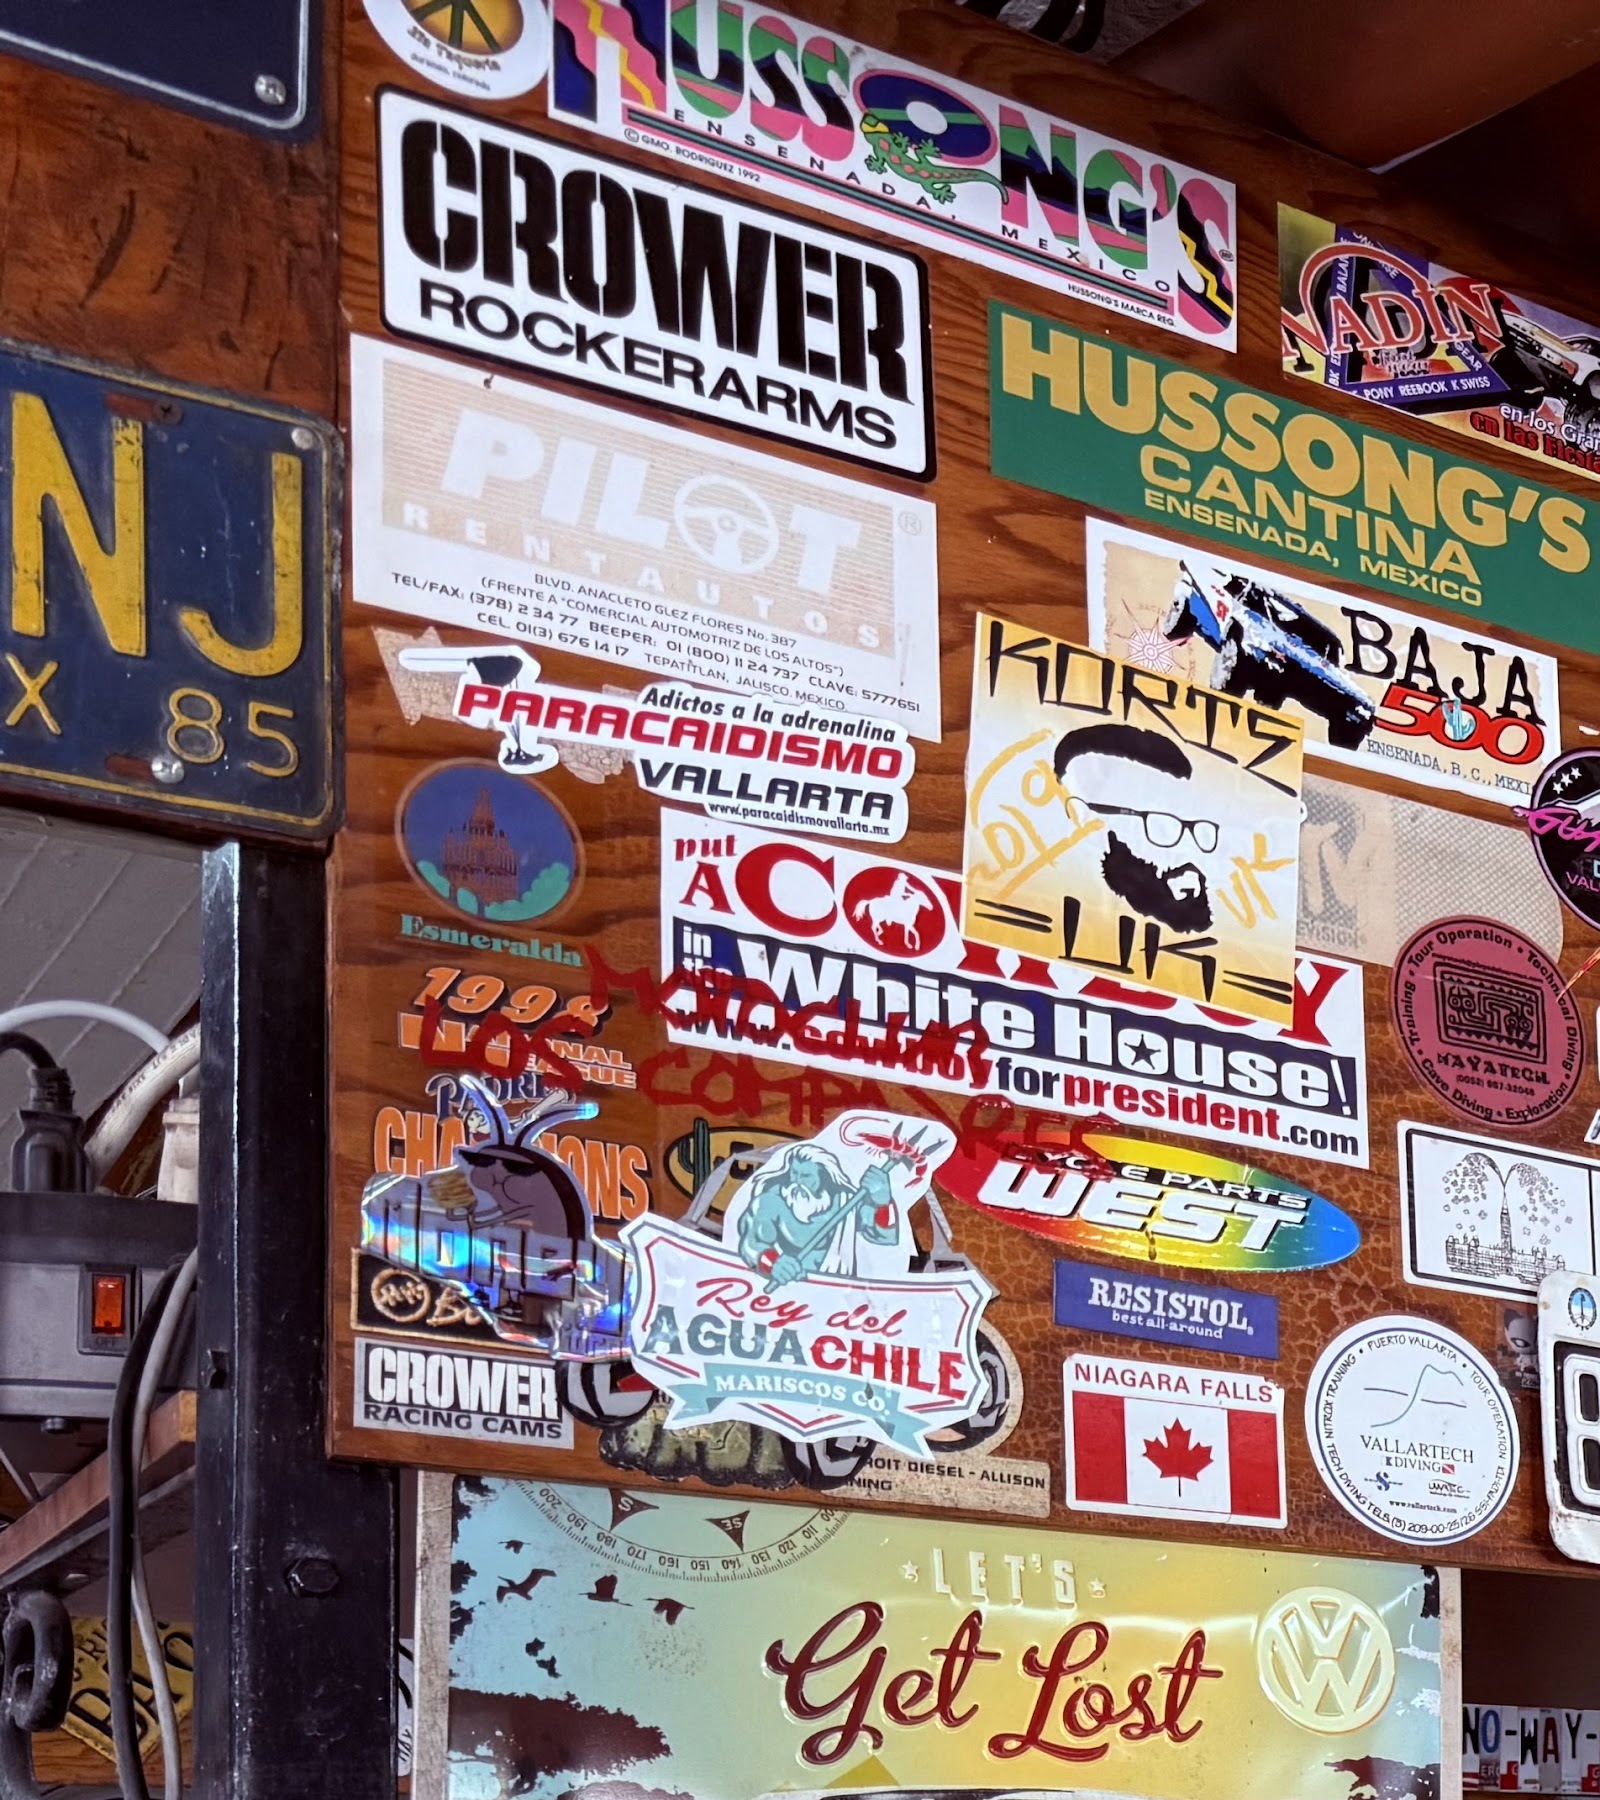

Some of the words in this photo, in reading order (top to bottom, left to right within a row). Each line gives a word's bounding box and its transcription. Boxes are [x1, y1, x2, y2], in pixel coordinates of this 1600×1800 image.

[676, 146, 734, 175] RODRIGUEZ
[736, 167, 761, 182] 1992
[674, 108, 955, 220] ENSENADA,
[1001, 224, 1171, 293] MEXICO
[401, 120, 912, 405] CROWER
[420, 278, 897, 450] ROCKERARMS
[1364, 386, 1394, 400] PONY
[1399, 380, 1448, 398] REEBOOK
[1002, 313, 1590, 572] HUSSONG'S
[1141, 445, 1480, 584] CANTINA
[1145, 489, 1340, 567] ENSENADA,
[1360, 555, 1482, 606] MEXICO
[579, 582, 650, 616] ANACLETO
[691, 609, 743, 637] FLORES
[651, 618, 741, 655] AUTOMOTRIZ
[1341, 607, 1545, 727] BAJA
[167, 688, 299, 777] 85
[458, 684, 901, 779] PARACAIDISMO
[642, 686, 724, 718] Adictos
[753, 702, 774, 724] la
[781, 705, 896, 743] adrenalina
[1375, 684, 1545, 765] 500
[639, 758, 894, 820] VALLARTA
[709, 802, 891, 837] www.paracaidismovallarta.mx
[673, 835, 738, 864] put
[682, 861, 735, 914] A
[400, 914, 582, 967] Esmeralda
[683, 925, 712, 958] in
[1436, 930, 1513, 949] Operation
[414, 967, 612, 1036] 1998
[738, 939, 1035, 1050] White
[1054, 1007, 1357, 1118] House!
[1437, 1053, 1550, 1085] MAYATECH
[1506, 1081, 1568, 1120] Exploration
[978, 1162, 1309, 1253] WEST
[1175, 1171, 1310, 1211] PARTS
[697, 1277, 813, 1327] Rey
[826, 1304, 907, 1338] del
[1087, 1277, 1246, 1331] RESISTOL
[641, 1304, 968, 1401] AGUACHILE
[368, 1347, 560, 1420] CROWER
[714, 1373, 848, 1403] MARISCOS
[1073, 1361, 1190, 1396] NIAGARA
[1200, 1375, 1274, 1403] FALLS
[364, 1403, 472, 1430] RACING
[481, 1415, 562, 1440] CAMS
[1360, 1435, 1474, 1464] VALLARTECH
[908, 1461, 965, 1480] DIESEL
[980, 1469, 1046, 1490] ALLISON
[1394, 1456, 1441, 1473] DIVING
[934, 1547, 1080, 1606] LET'S
[767, 1599, 1001, 1766] Get
[988, 1619, 1223, 1763] Lost
